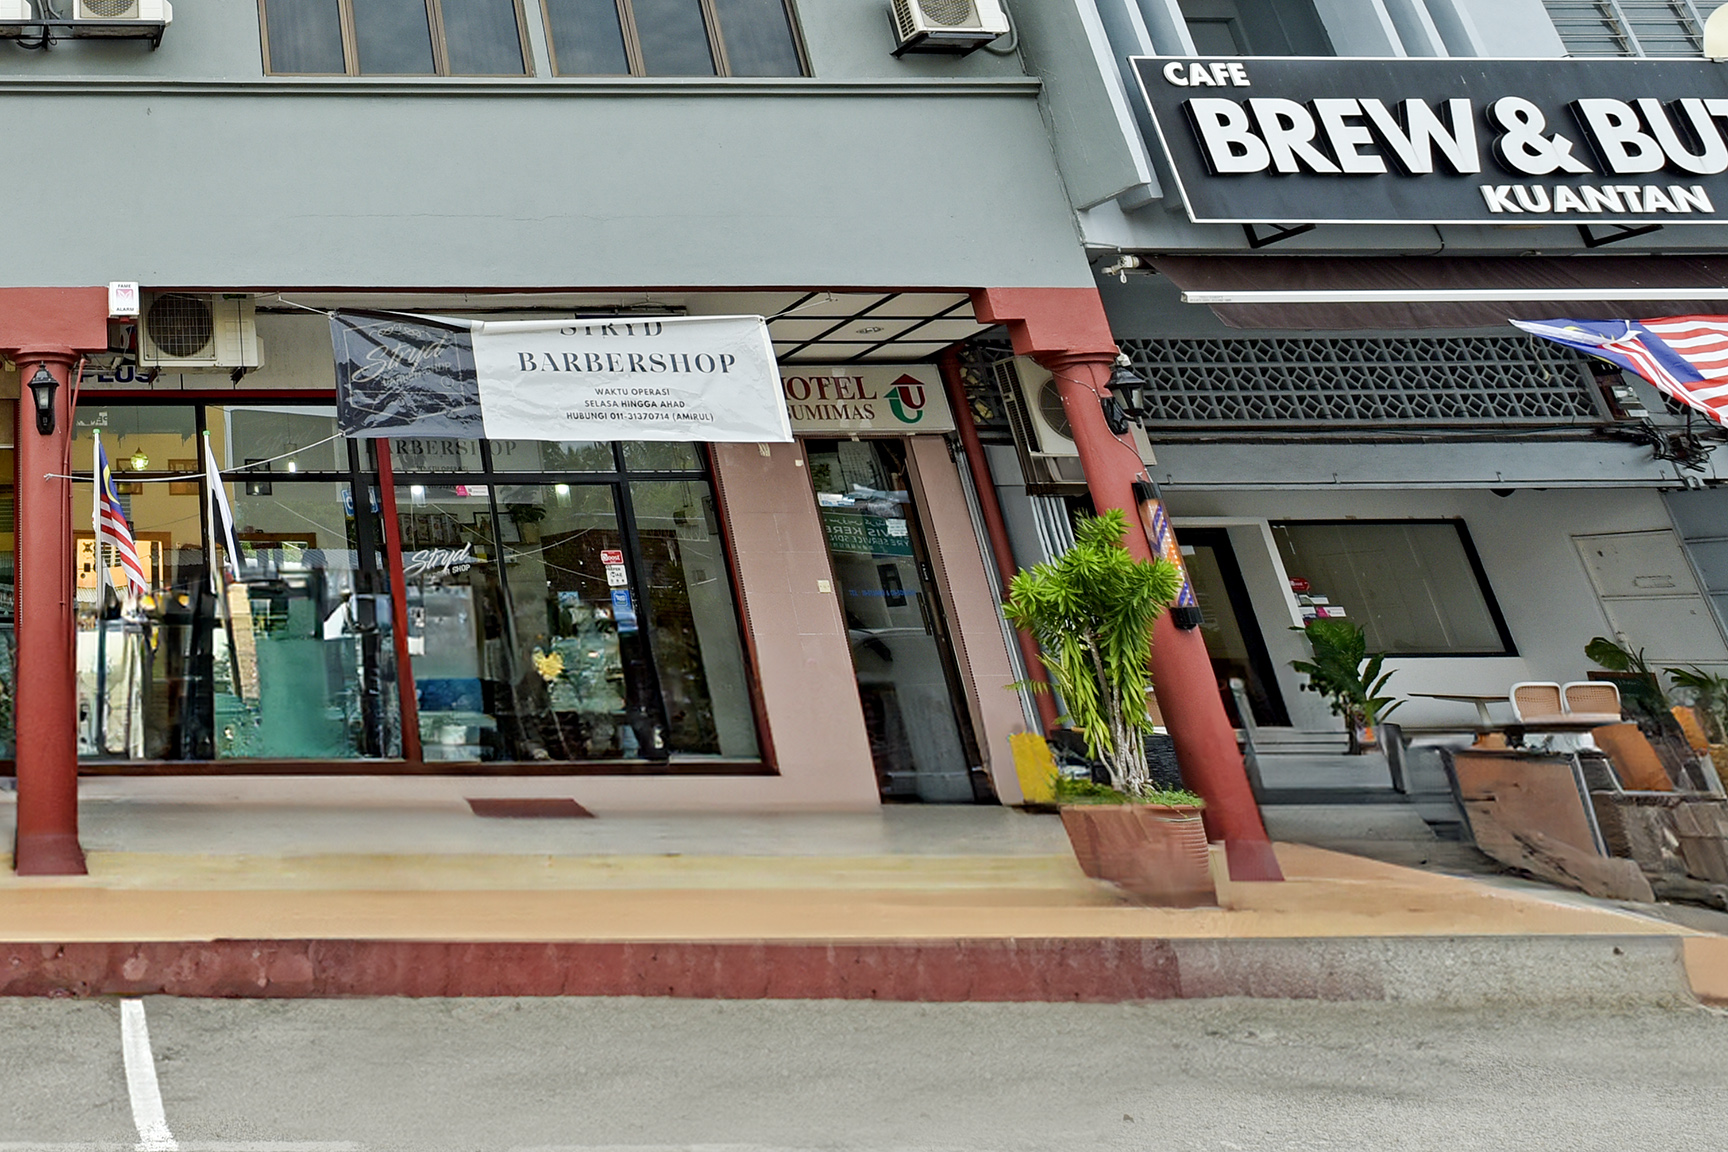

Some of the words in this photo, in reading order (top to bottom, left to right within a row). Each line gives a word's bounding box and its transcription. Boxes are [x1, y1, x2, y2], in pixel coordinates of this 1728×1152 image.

[1163, 62, 1251, 87] CAFE
[1183, 97, 1481, 176] BREW
[1491, 96, 1594, 176] &
[1574, 97, 1728, 176] BU
[1481, 184, 1715, 214] KUANTAN
[517, 352, 736, 374] BARBERSHOP
[594, 388, 629, 396] WAKTU
[630, 388, 670, 396] OPERASI
[780, 376, 878, 401] OTEL
[584, 400, 619, 408] SELASA
[621, 400, 658, 408] HINGGA
[660, 400, 685, 408] AHAD
[566, 412, 608, 420] HUBUNGI
[610, 412, 670, 420] 011-31370714
[672, 413, 714, 422] (AMIRUL)
[402, 541, 472, 578] Stryd
